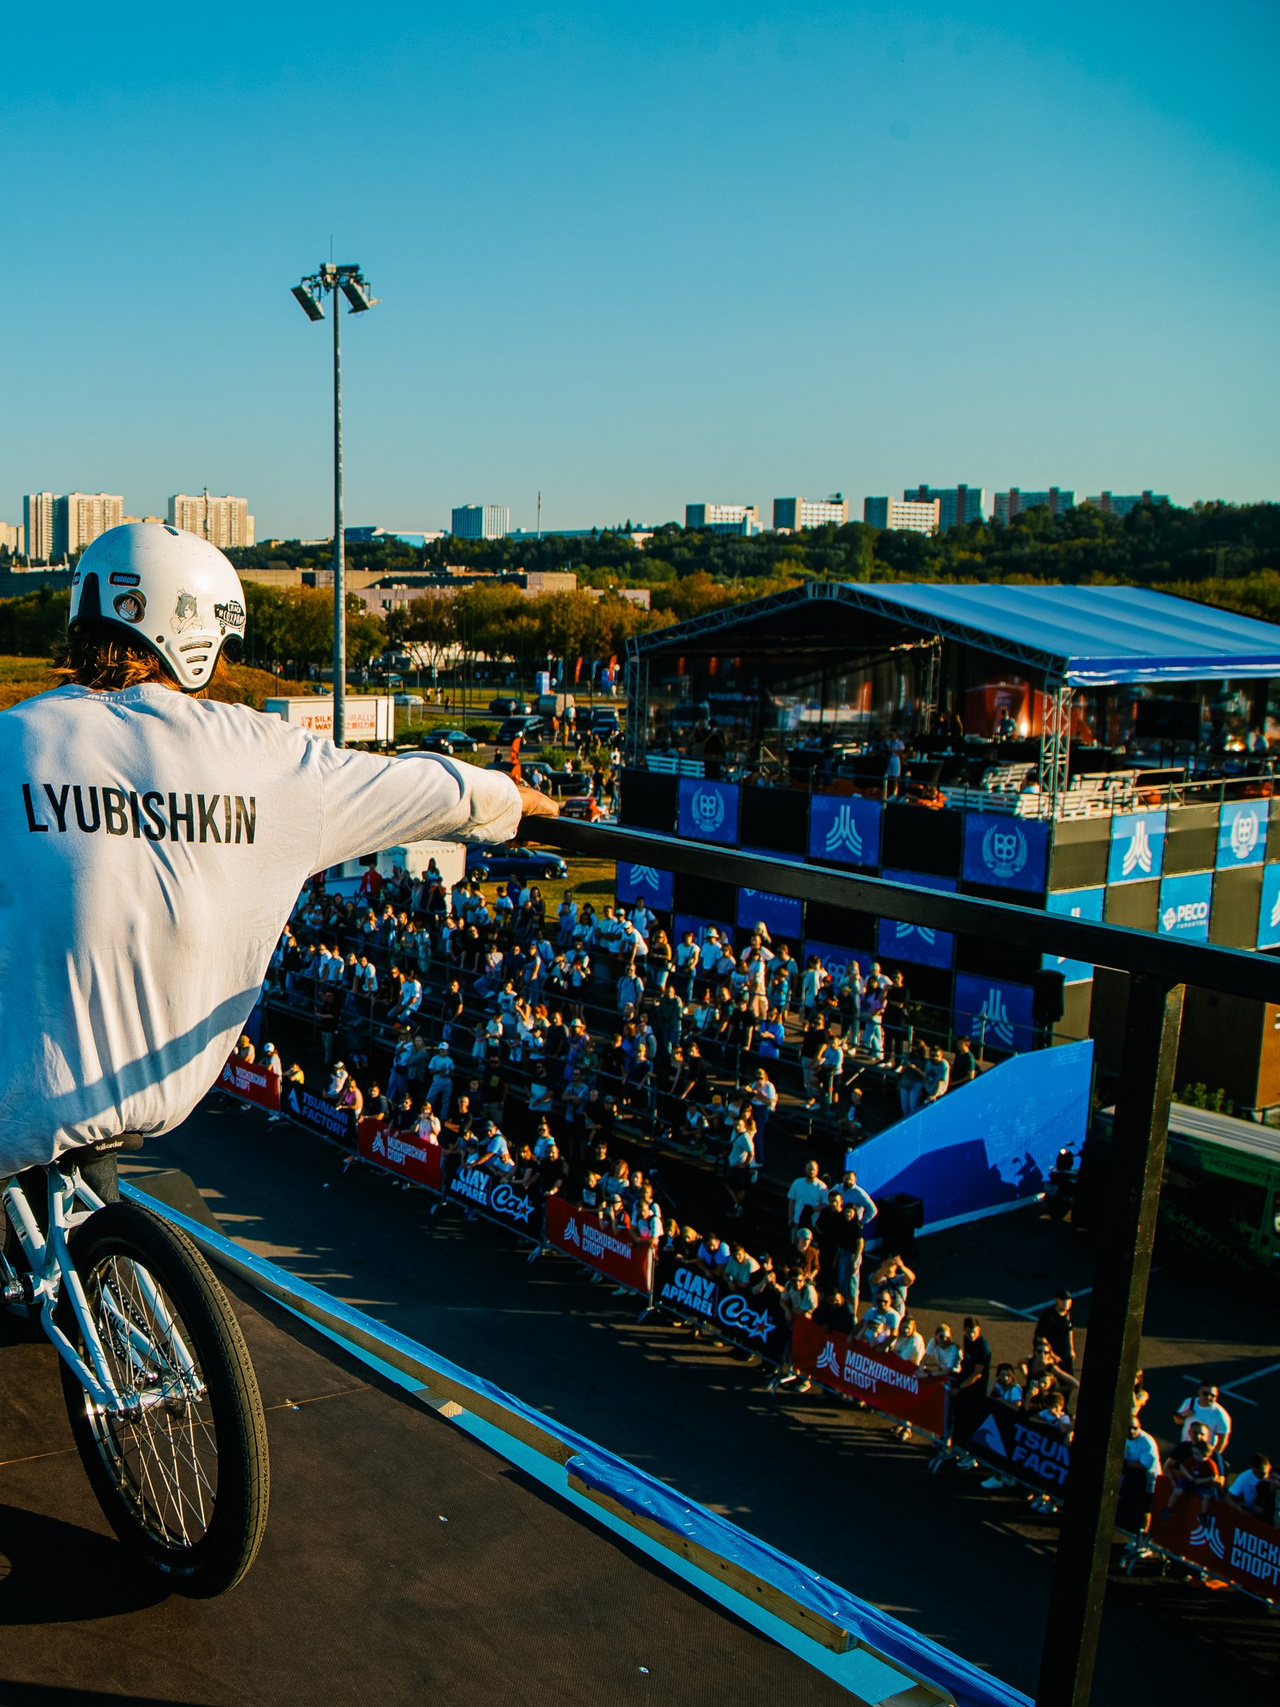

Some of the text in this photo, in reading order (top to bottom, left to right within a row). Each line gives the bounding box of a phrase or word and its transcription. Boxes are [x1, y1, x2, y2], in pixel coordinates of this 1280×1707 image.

[22, 783, 256, 844] LYUBISHKIN
[302, 1091, 349, 1126] TSUNAMI
[302, 1105, 348, 1138] FACTORY
[387, 1135, 427, 1164] МОСКОВСКИЙ
[387, 1149, 406, 1166] СПОРТ
[450, 1178, 488, 1206] APPAREL
[582, 1223, 632, 1260] МОСКОВСКИЙ
[582, 1237, 605, 1260] СПОРТ
[661, 1283, 713, 1317] APPAREL
[843, 1365, 878, 1394] СПОРТ
[845, 1349, 919, 1395] МОСКОВСКИЙ
[1013, 1423, 1070, 1467] TSUN
[1011, 1446, 1069, 1485] FACT
[1233, 1527, 1280, 1566] МОСК
[1230, 1546, 1280, 1586] СПОРТ
